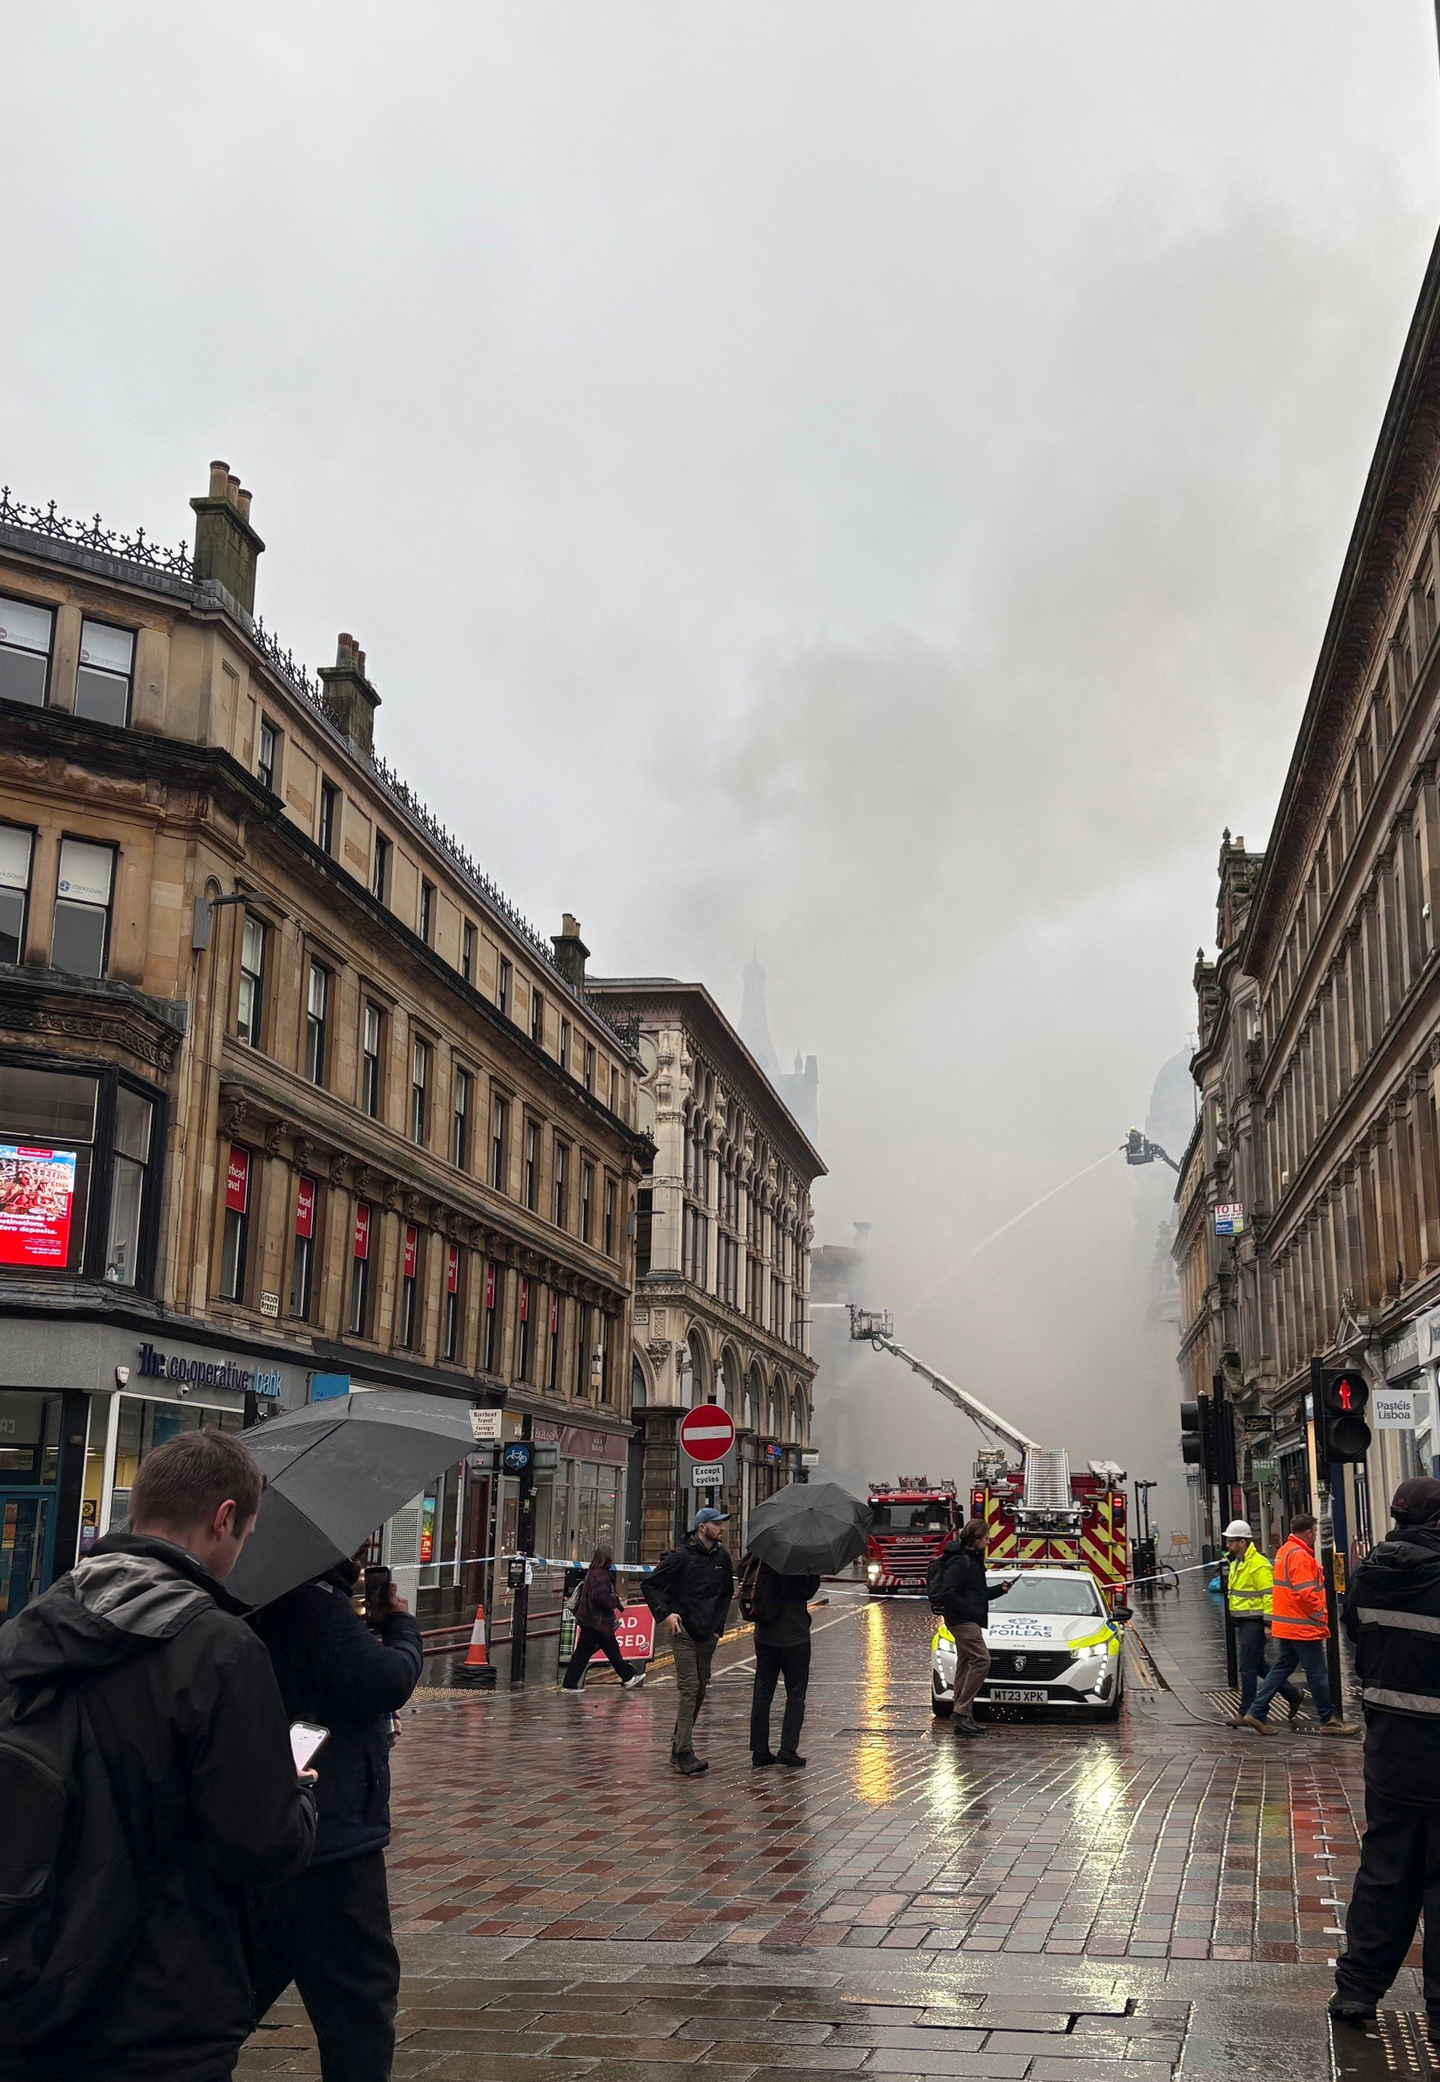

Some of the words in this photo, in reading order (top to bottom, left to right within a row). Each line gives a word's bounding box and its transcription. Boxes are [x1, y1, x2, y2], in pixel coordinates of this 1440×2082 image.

[228, 1164, 246, 1180] rhead
[227, 1180, 240, 1192] avel
[1216, 1205, 1229, 1214] TO
[1232, 1204, 1243, 1213] LE
[252, 1365, 282, 1397] bank
[1378, 1410, 1411, 1420] Lisboa
[695, 1467, 721, 1476] Except
[696, 1475, 720, 1484] cycles
[618, 1616, 638, 1628] AD
[989, 1629, 1052, 1638] POILEAS
[616, 1634, 647, 1647] SED
[994, 1690, 1021, 1701] MT23
[1023, 1691, 1044, 1702] XPK
